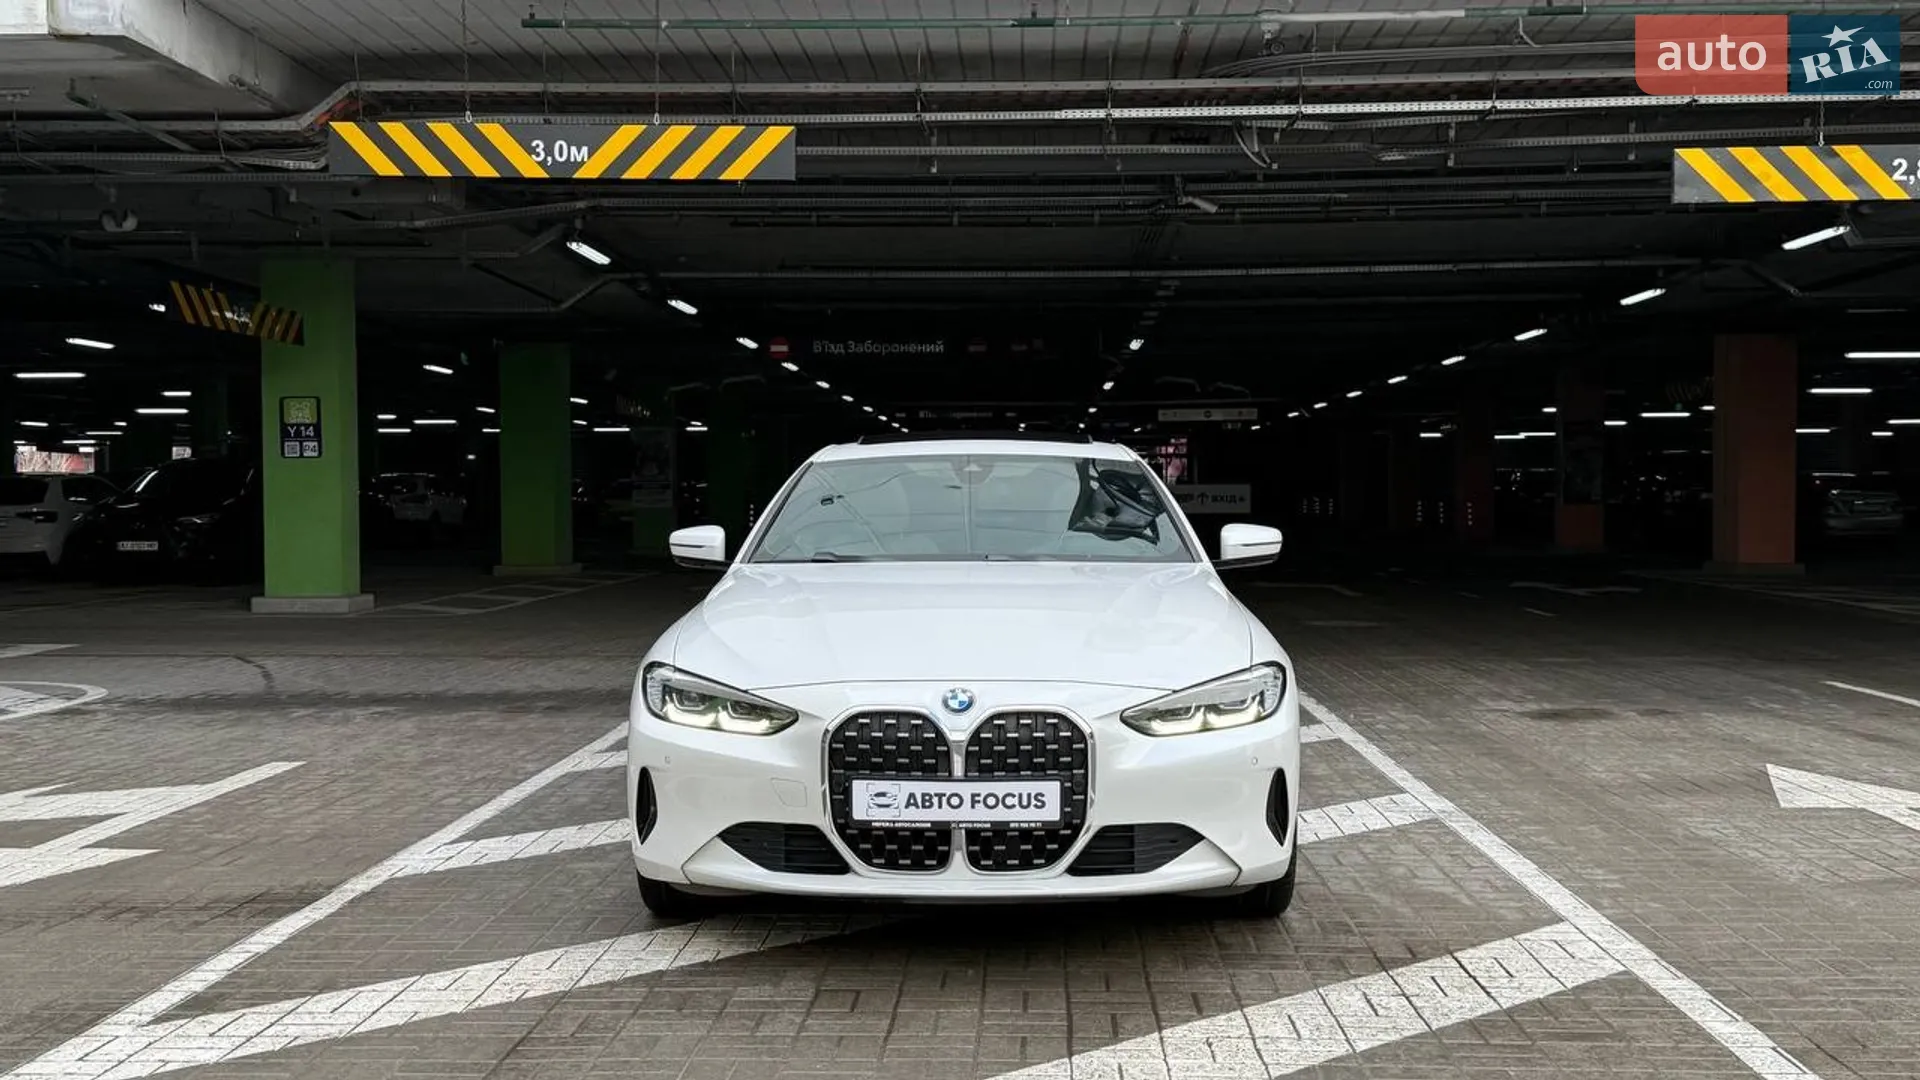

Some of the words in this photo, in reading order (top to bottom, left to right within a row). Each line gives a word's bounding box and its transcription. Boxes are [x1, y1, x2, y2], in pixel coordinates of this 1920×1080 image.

[1892, 157, 1920, 185] 2,
[847, 339, 945, 356] Заборонений
[287, 425, 297, 438] Y
[300, 425, 315, 438] 14
[904, 792, 964, 810] АВТО
[970, 792, 1047, 810] FOCUS
